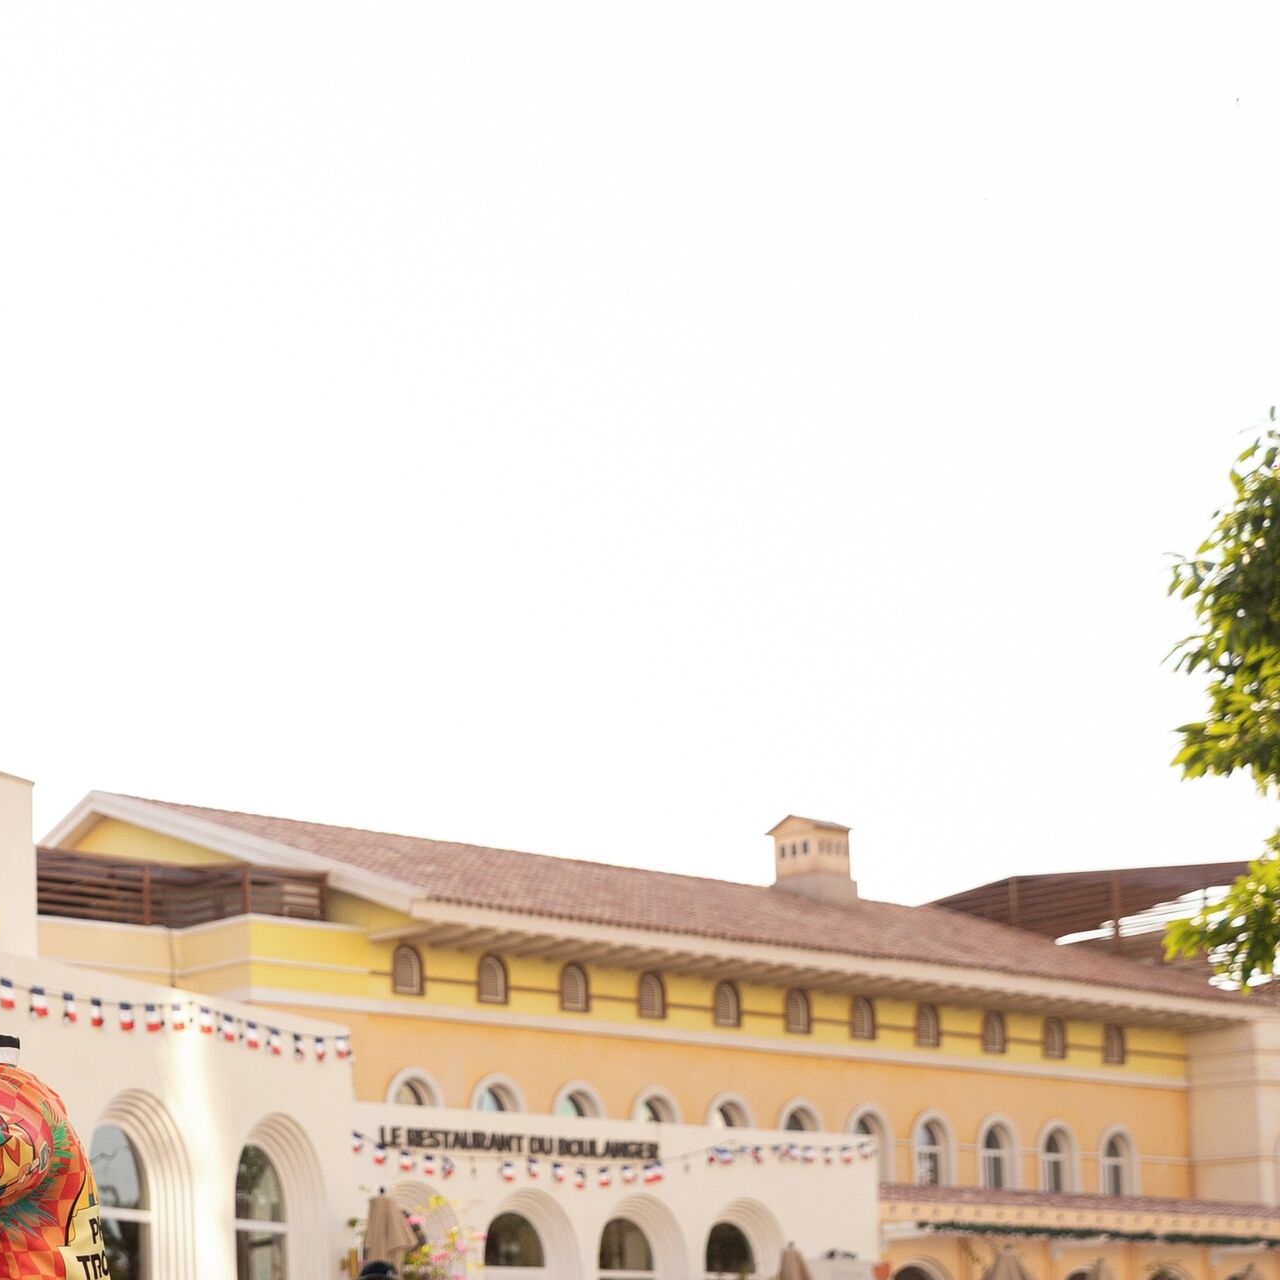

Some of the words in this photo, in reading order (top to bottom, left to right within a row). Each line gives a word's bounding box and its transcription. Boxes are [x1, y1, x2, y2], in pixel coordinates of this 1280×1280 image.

[379, 1125, 401, 1148] LE
[407, 1128, 524, 1151] RESTAURANT
[530, 1136, 553, 1155] DU
[558, 1138, 659, 1160] BOULANGER
